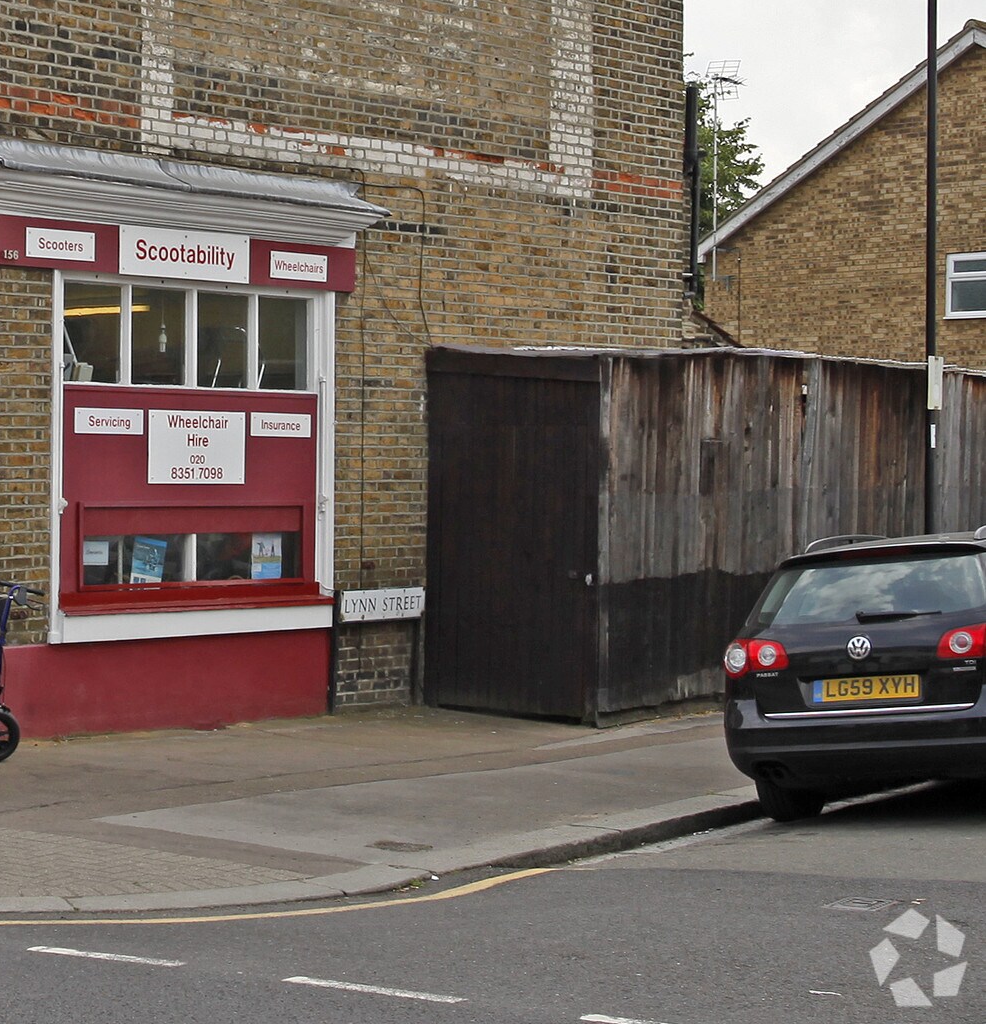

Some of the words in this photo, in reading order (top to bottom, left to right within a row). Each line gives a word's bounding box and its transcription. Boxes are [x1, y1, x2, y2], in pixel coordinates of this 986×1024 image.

[38, 237, 84, 253] Scooters
[3, 250, 19, 260] 156
[136, 240, 235, 270] Scootability
[274, 259, 324, 274] Wheelchairs
[88, 415, 131, 429] Servicing
[167, 415, 228, 429] Wheelchair
[261, 419, 300, 431] Insurance
[187, 434, 209, 447] Hire
[190, 455, 205, 464] 020
[345, 598, 376, 613] LYNN
[383, 595, 422, 611] STREET
[826, 679, 873, 698] LG59
[879, 676, 915, 694] XYH
